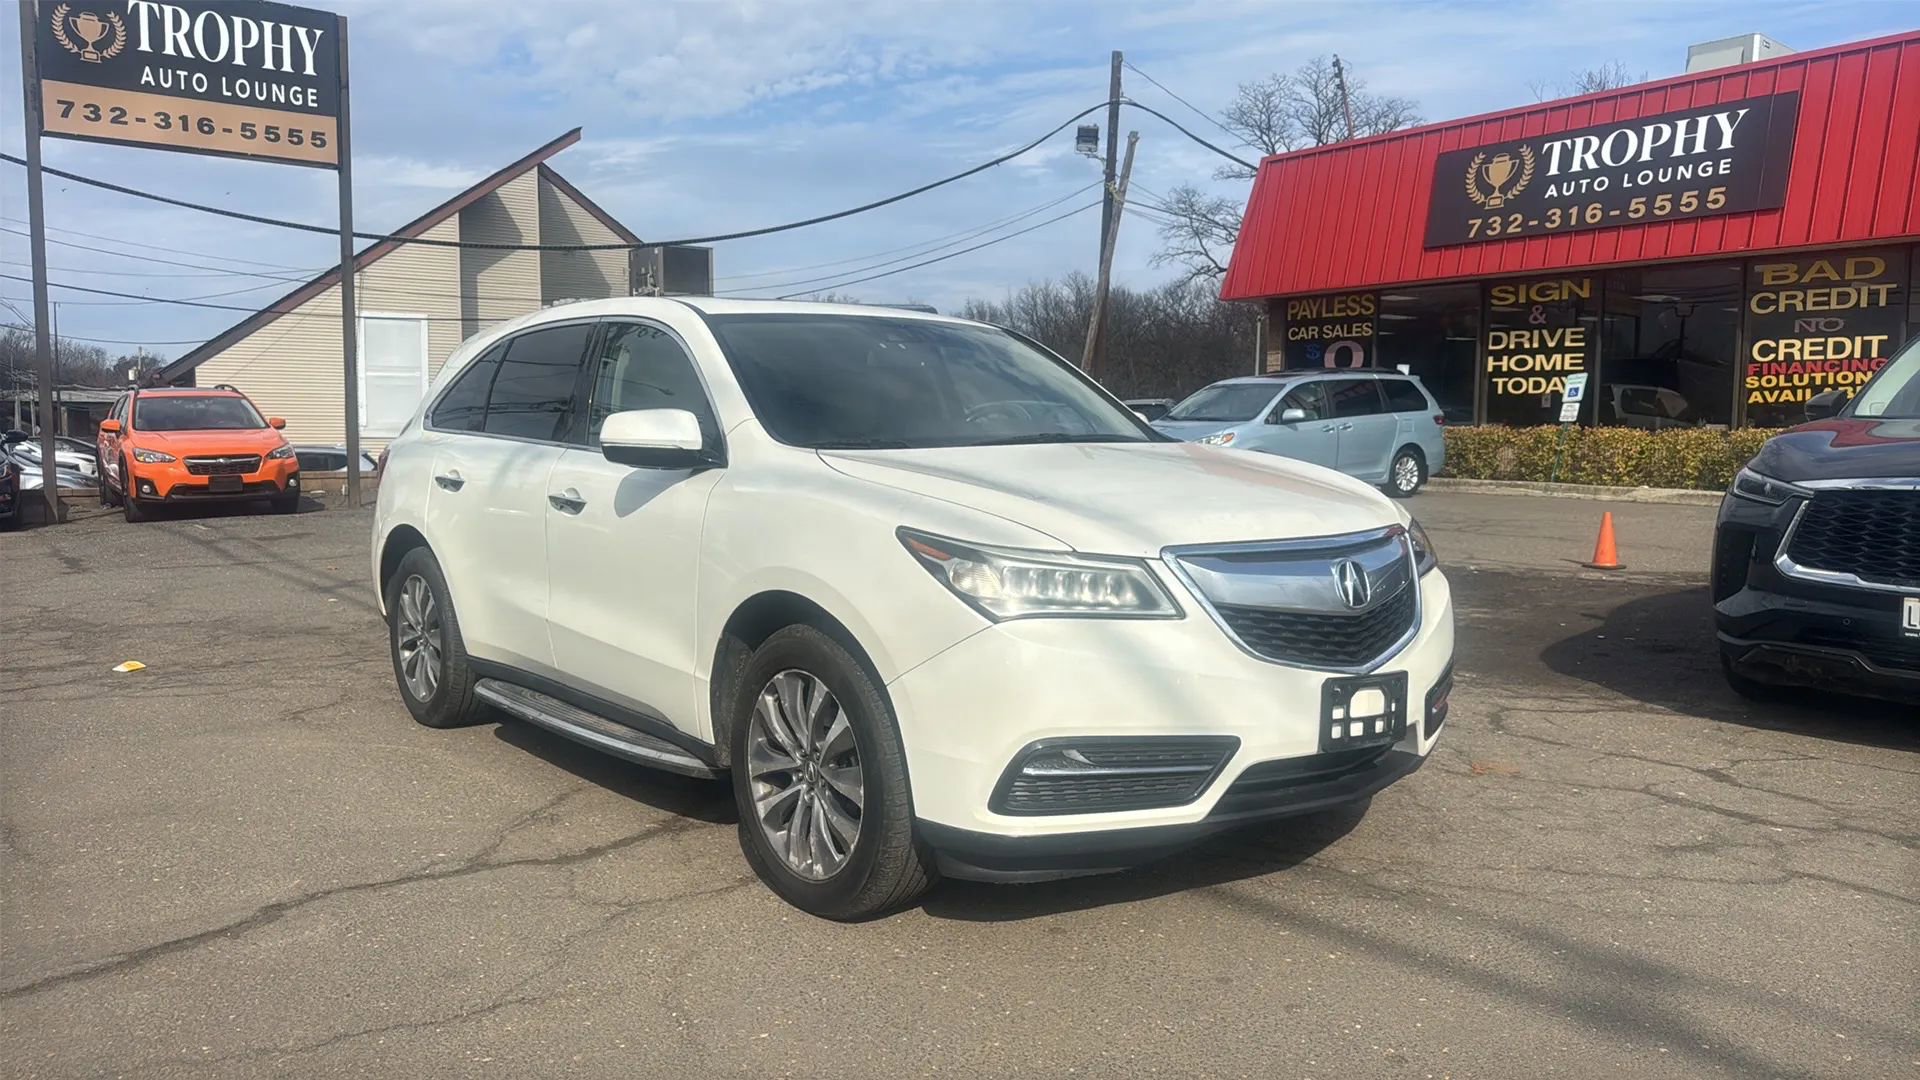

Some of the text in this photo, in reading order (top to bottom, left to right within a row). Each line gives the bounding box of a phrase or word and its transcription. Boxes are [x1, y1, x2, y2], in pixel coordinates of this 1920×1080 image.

[128, 0, 324, 76] TROPHY
[140, 65, 319, 108] AUTO LOUNGE
[56, 99, 328, 149] 732-316-5555
[1542, 108, 1750, 177] TROPHY
[1544, 158, 1732, 199] AUTO LOUNGE
[1467, 186, 1727, 239] 732-316-5555
[1761, 256, 1887, 286] BAD
[1490, 279, 1591, 306] SIGN
[1750, 283, 1898, 314] CREDIT
[1287, 294, 1376, 321] PAYLESS
[1528, 304, 1547, 325] &
[1288, 322, 1373, 341] CAR SALES
[1488, 327, 1586, 350] DRIVE
[1793, 317, 1845, 333] NO
[1751, 335, 1889, 362] CREDIT
[1487, 353, 1585, 372] HOME
[1747, 358, 1889, 375] FINANCING
[1745, 371, 1873, 388] SOLUTION
